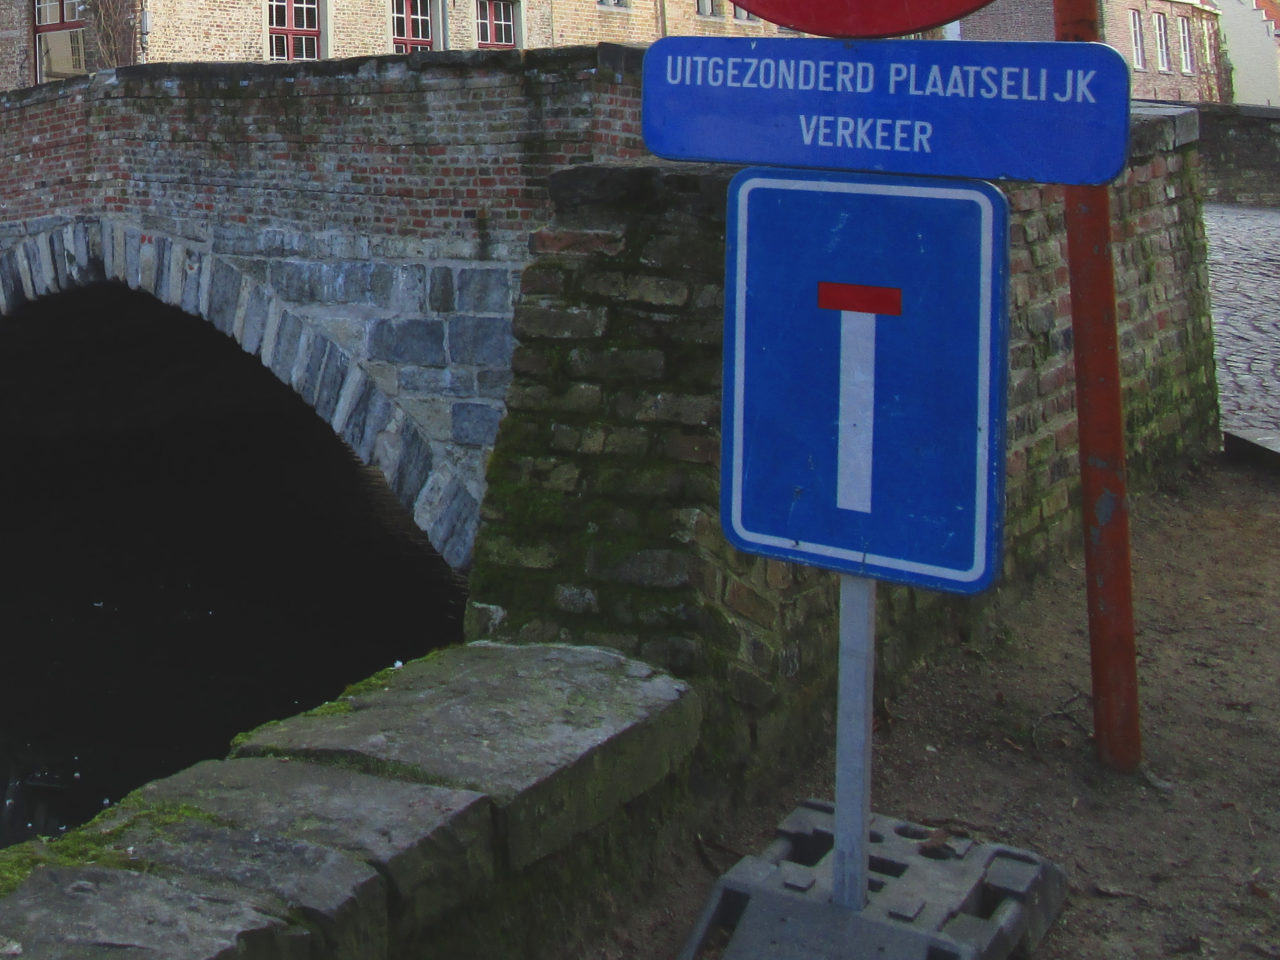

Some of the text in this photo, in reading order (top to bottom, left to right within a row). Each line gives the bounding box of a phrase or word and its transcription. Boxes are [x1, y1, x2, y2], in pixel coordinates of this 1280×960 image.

[665, 55, 1098, 104] UITGEZONDERD PLAATSELIJK
[799, 115, 933, 154] VERKEER
